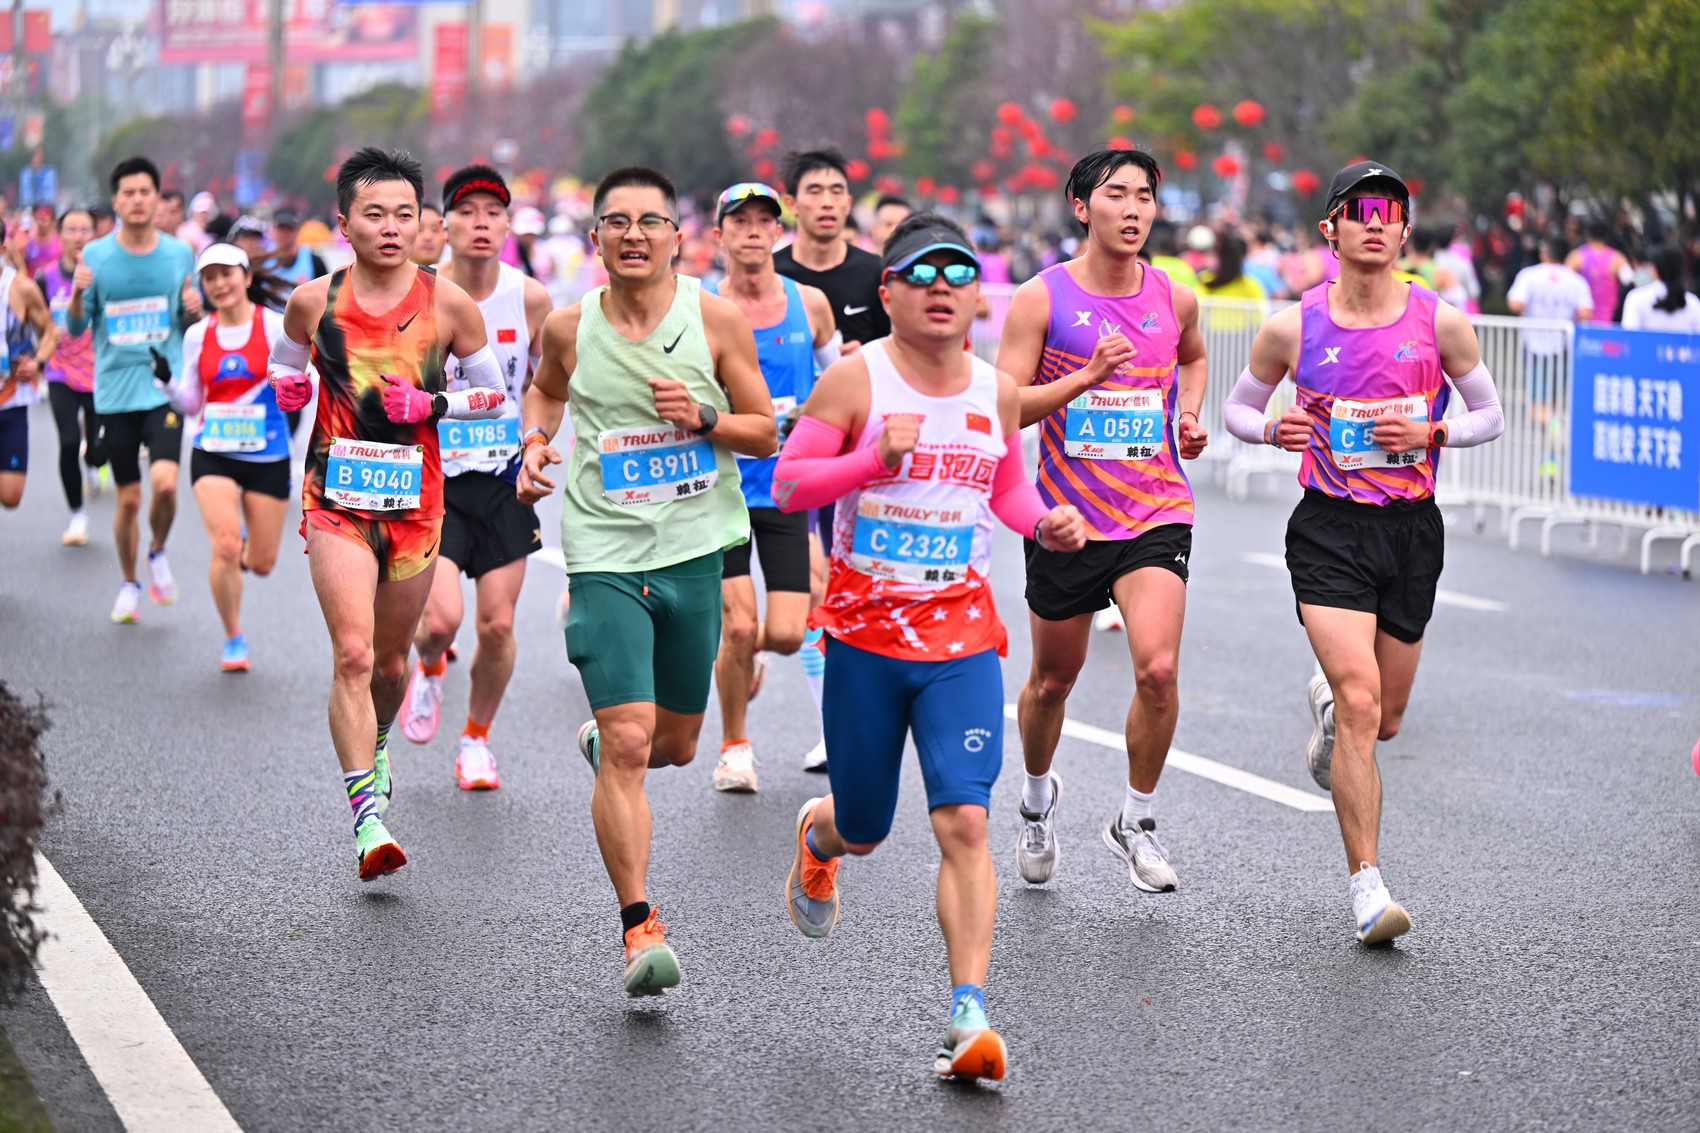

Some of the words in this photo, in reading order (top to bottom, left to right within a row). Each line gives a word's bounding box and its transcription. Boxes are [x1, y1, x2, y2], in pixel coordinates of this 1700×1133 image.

[1090, 396, 1130, 407] TRULY
[1133, 396, 1150, 407] 信利
[1350, 407, 1388, 418] TRULY
[1394, 404, 1414, 415] 信利
[449, 427, 462, 445] C
[468, 424, 507, 444] 1985
[1079, 417, 1095, 436] A
[1104, 418, 1154, 438] 0592
[621, 432, 667, 446] TRULY
[1341, 428, 1356, 448] C
[349, 445, 388, 458] TRULY
[393, 449, 411, 459] 信利
[623, 459, 640, 482] C
[648, 450, 699, 479] 8911
[872, 452, 996, 486] 昌跑团
[338, 465, 353, 485] B
[361, 468, 413, 490] 9040
[884, 505, 933, 520] TRULY
[939, 510, 962, 522] 信利
[870, 529, 889, 552] C
[897, 533, 958, 560] 2326
